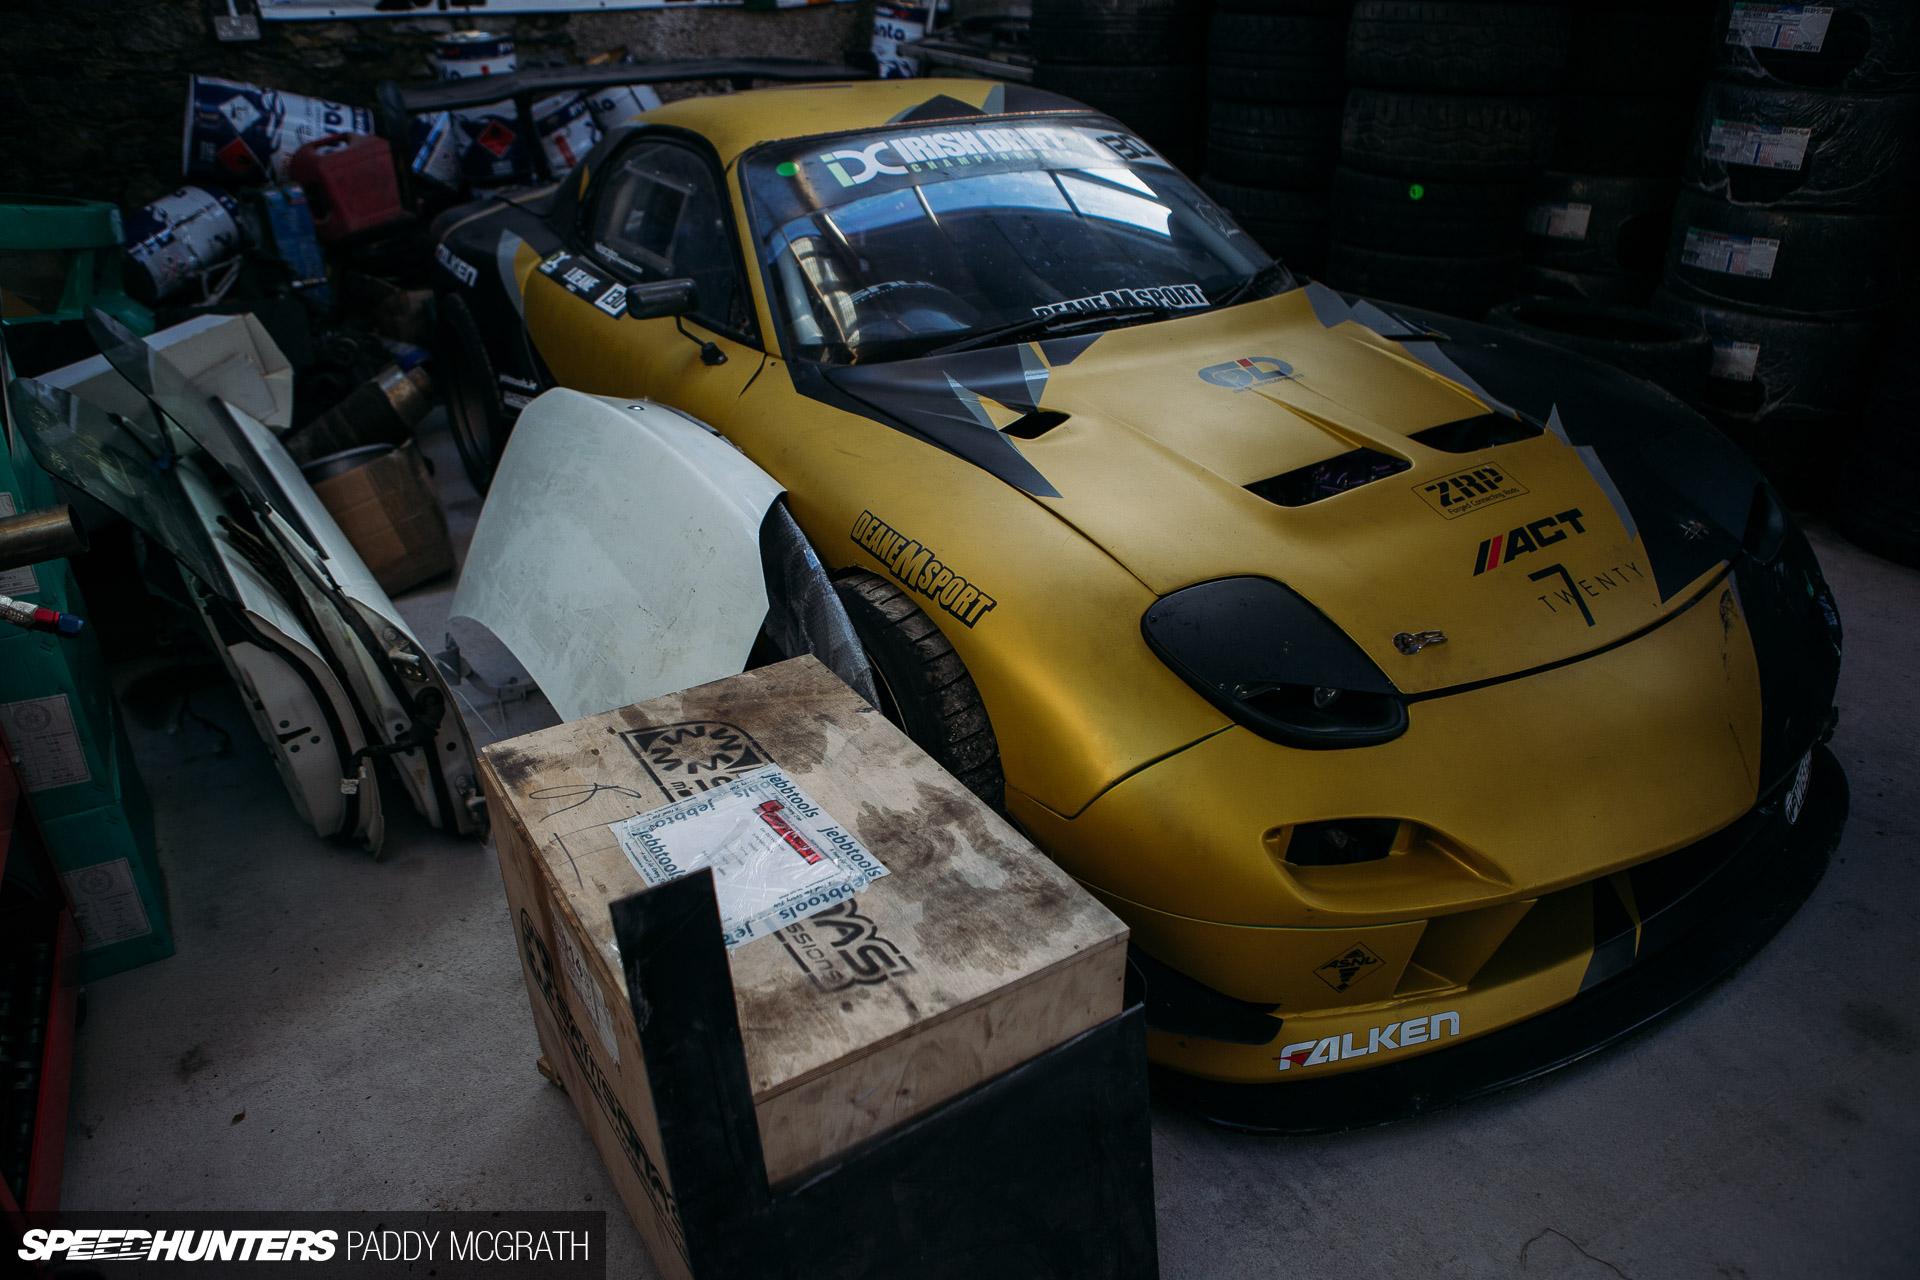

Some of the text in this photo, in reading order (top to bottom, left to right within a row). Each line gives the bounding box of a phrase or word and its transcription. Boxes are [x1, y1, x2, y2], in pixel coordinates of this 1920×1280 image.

[889, 126, 1069, 163] IRISH DRIFT
[1424, 468, 1504, 507] ZRP
[1537, 561, 1644, 613] TWENTY
[761, 772, 819, 819] jebbtools
[816, 826, 882, 877] jebbtools
[1272, 1010, 1460, 1071] FALKEN
